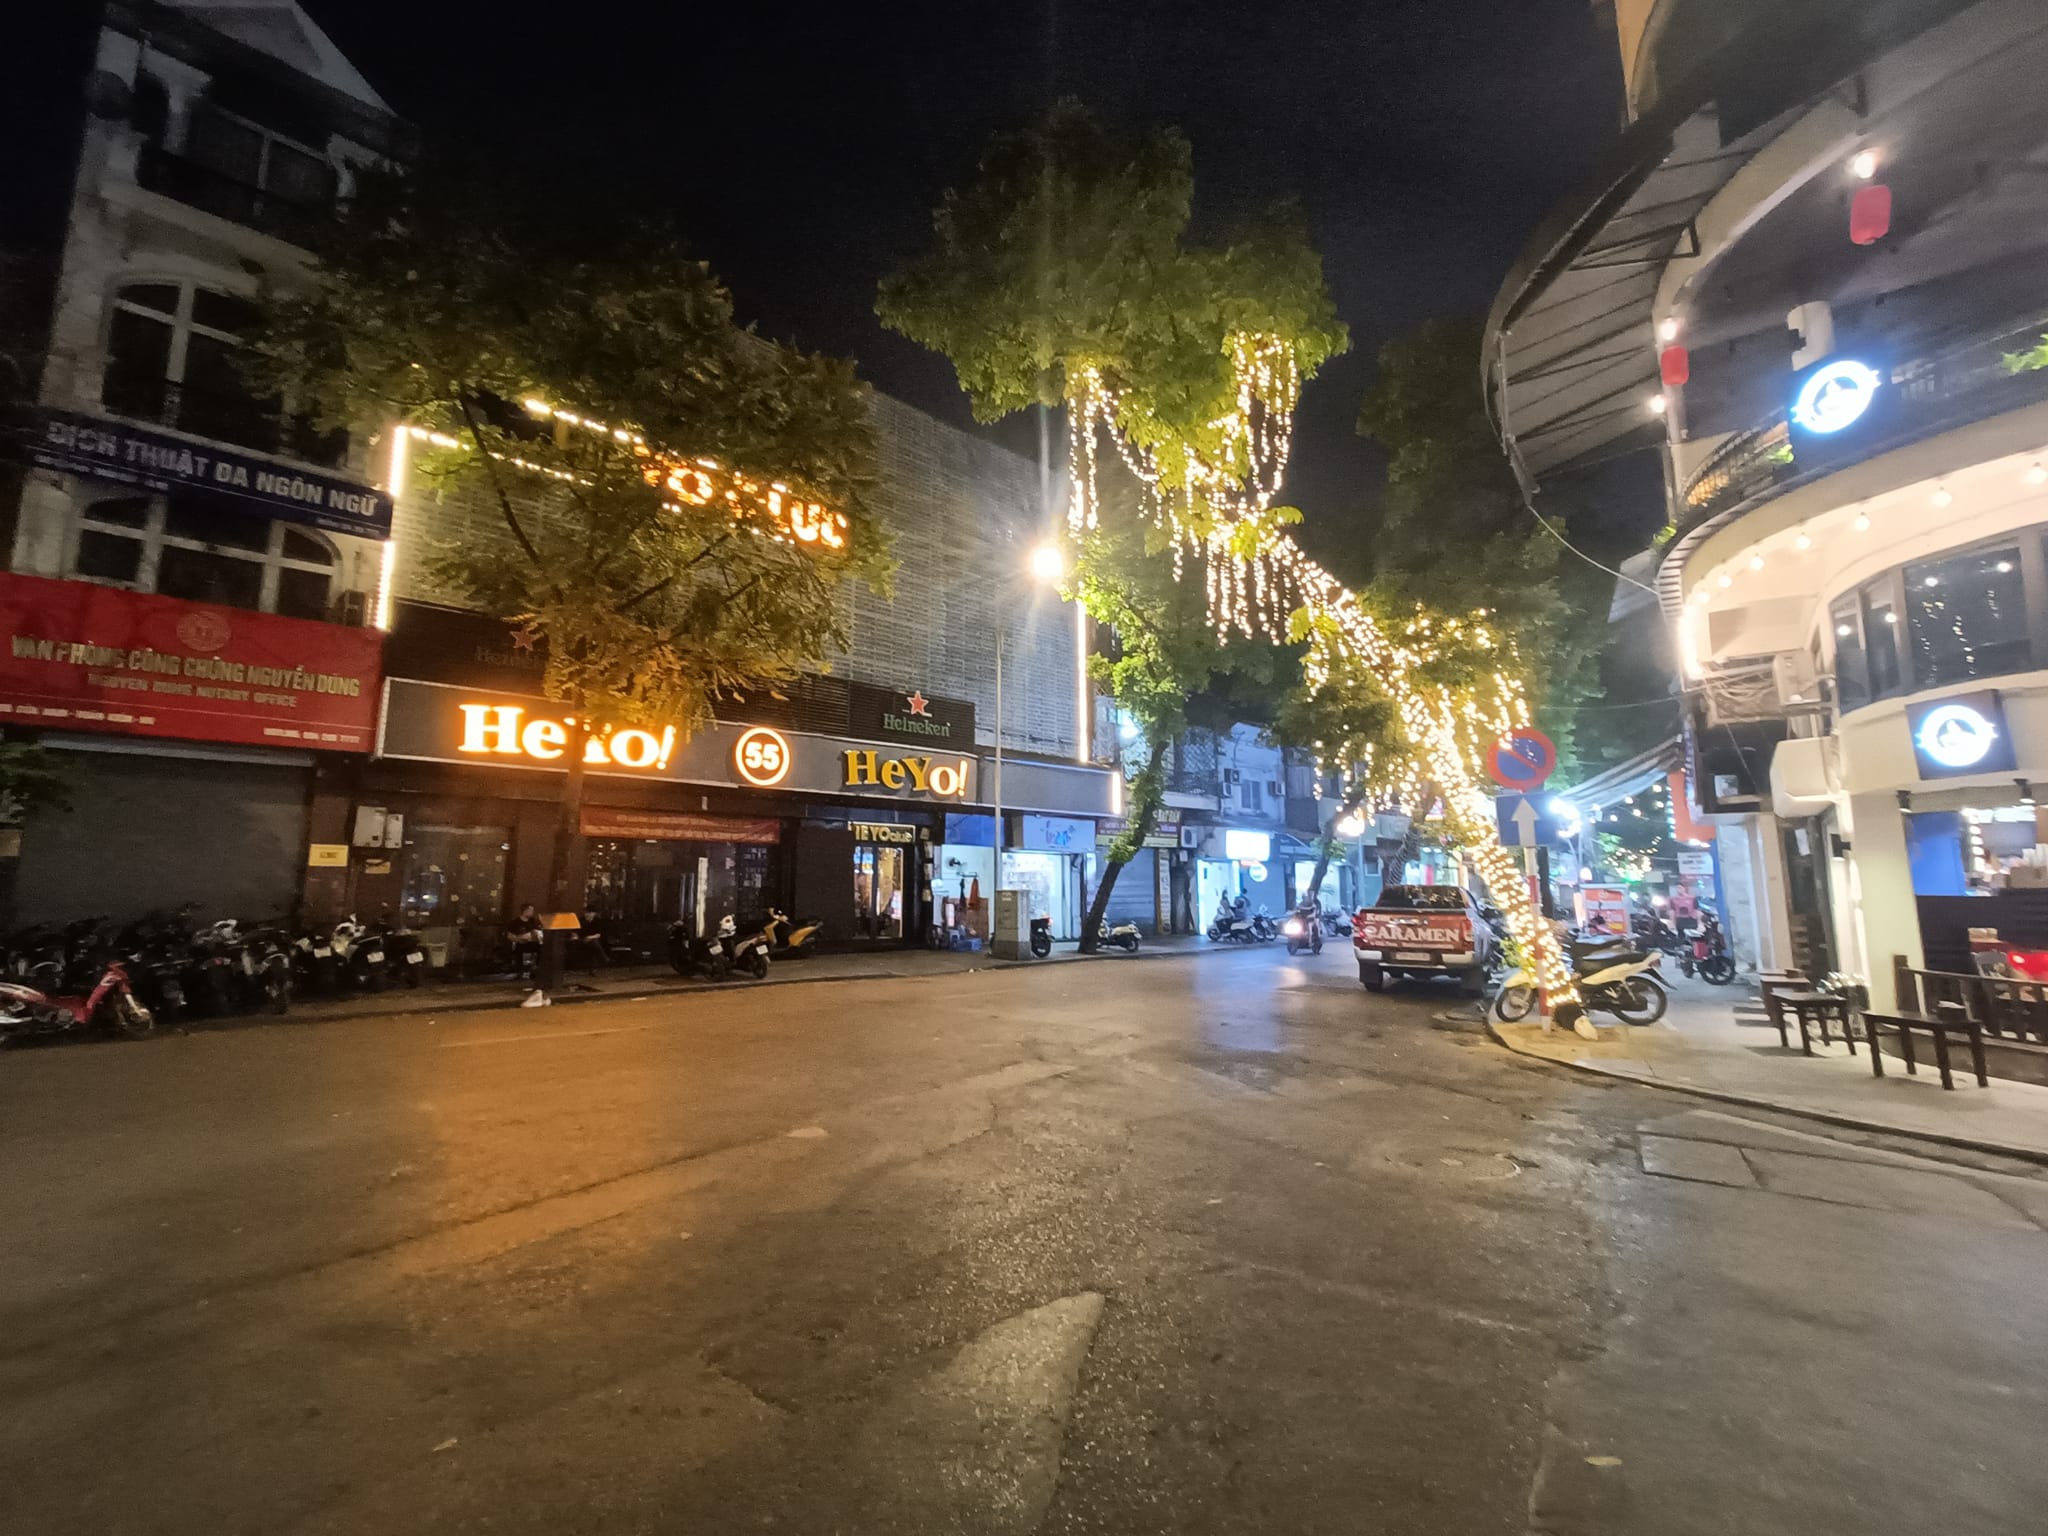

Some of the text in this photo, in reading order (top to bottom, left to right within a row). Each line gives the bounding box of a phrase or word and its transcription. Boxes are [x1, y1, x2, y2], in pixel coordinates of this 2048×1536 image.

[255, 470, 323, 505] NGÔN
[884, 713, 951, 738] Heineken
[745, 741, 781, 771] 55
[844, 749, 968, 797] HeYo!
[1362, 923, 1460, 942] CARAMEN
